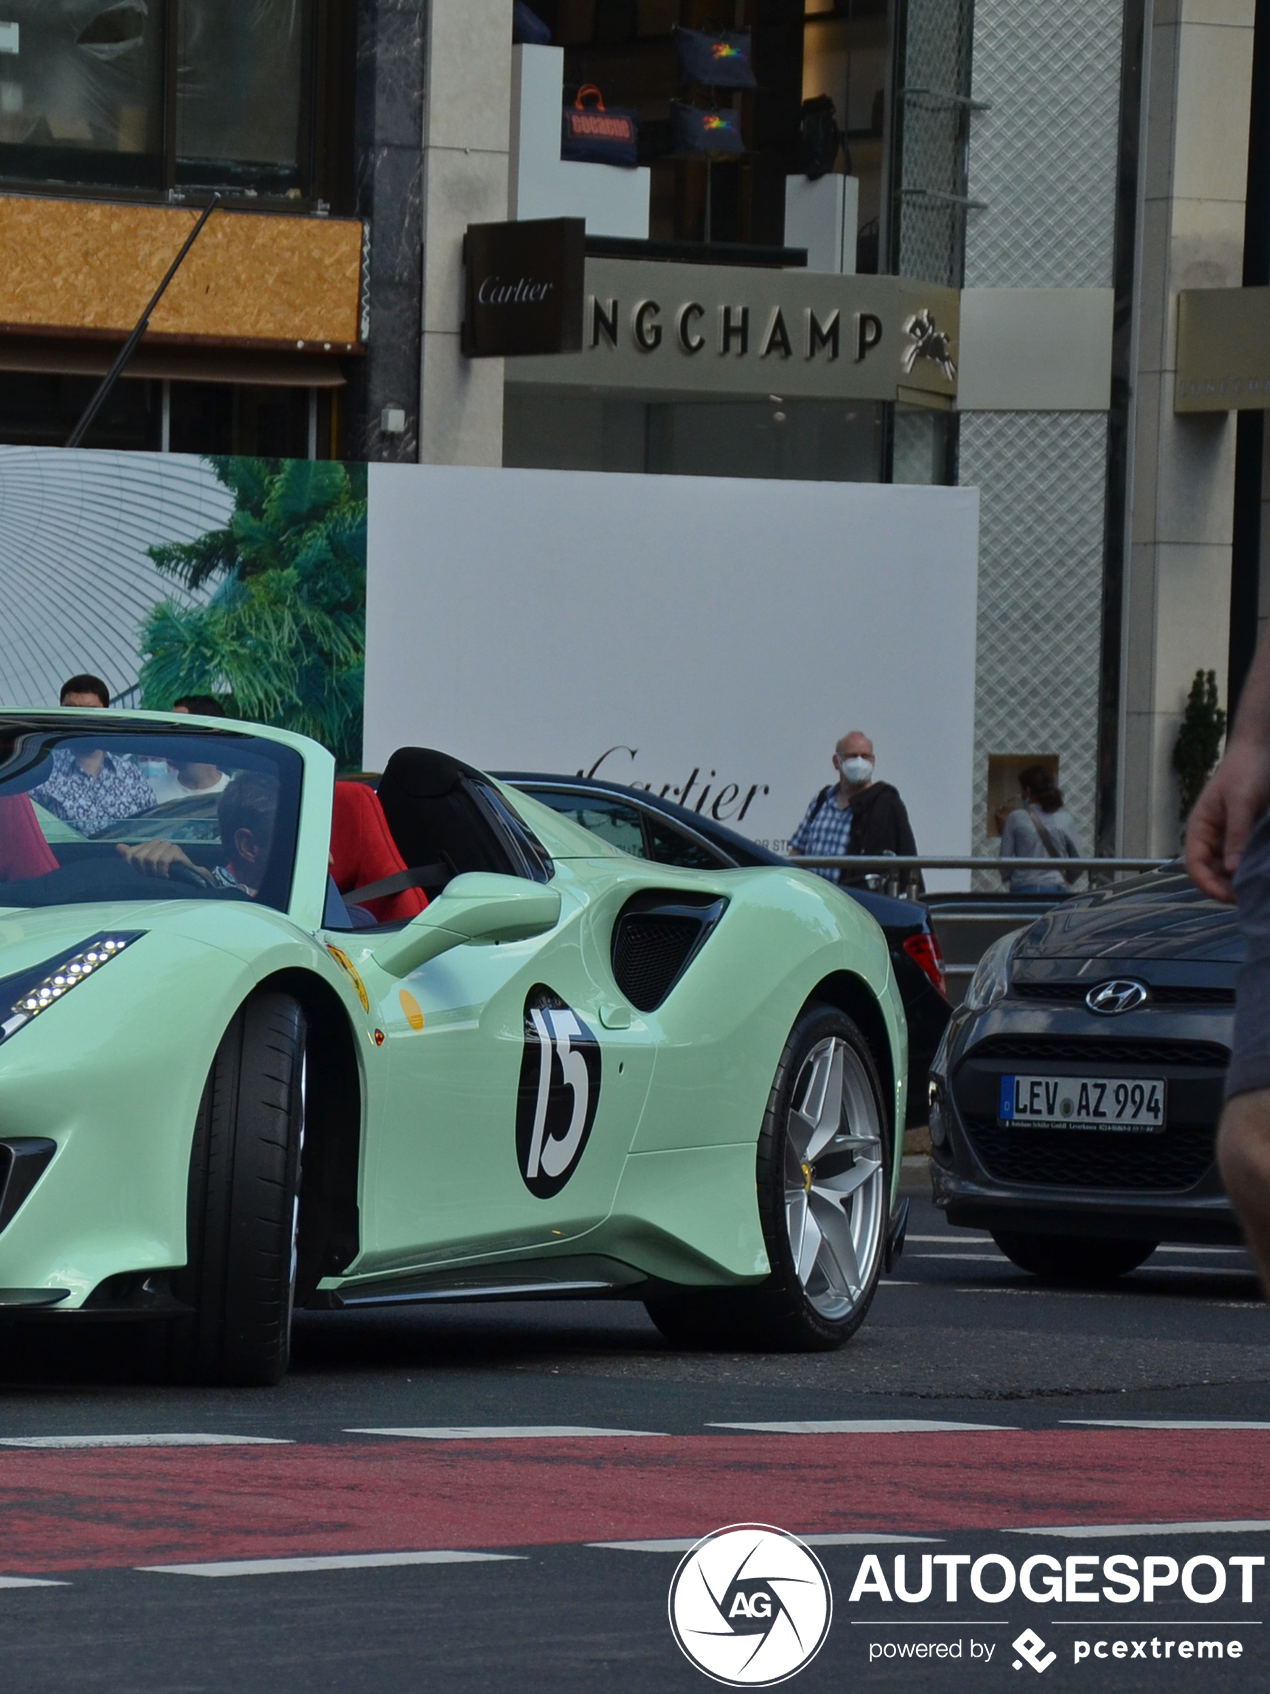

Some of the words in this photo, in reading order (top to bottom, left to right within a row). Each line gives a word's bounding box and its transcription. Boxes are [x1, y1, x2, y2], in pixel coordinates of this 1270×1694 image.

[478, 275, 554, 304] Cartier
[589, 295, 884, 363] NGCHAMP
[526, 1007, 589, 1178] 15
[1014, 1079, 1059, 1116] LEV
[1076, 1081, 1108, 1118] AZ
[1114, 1083, 1161, 1120] 994
